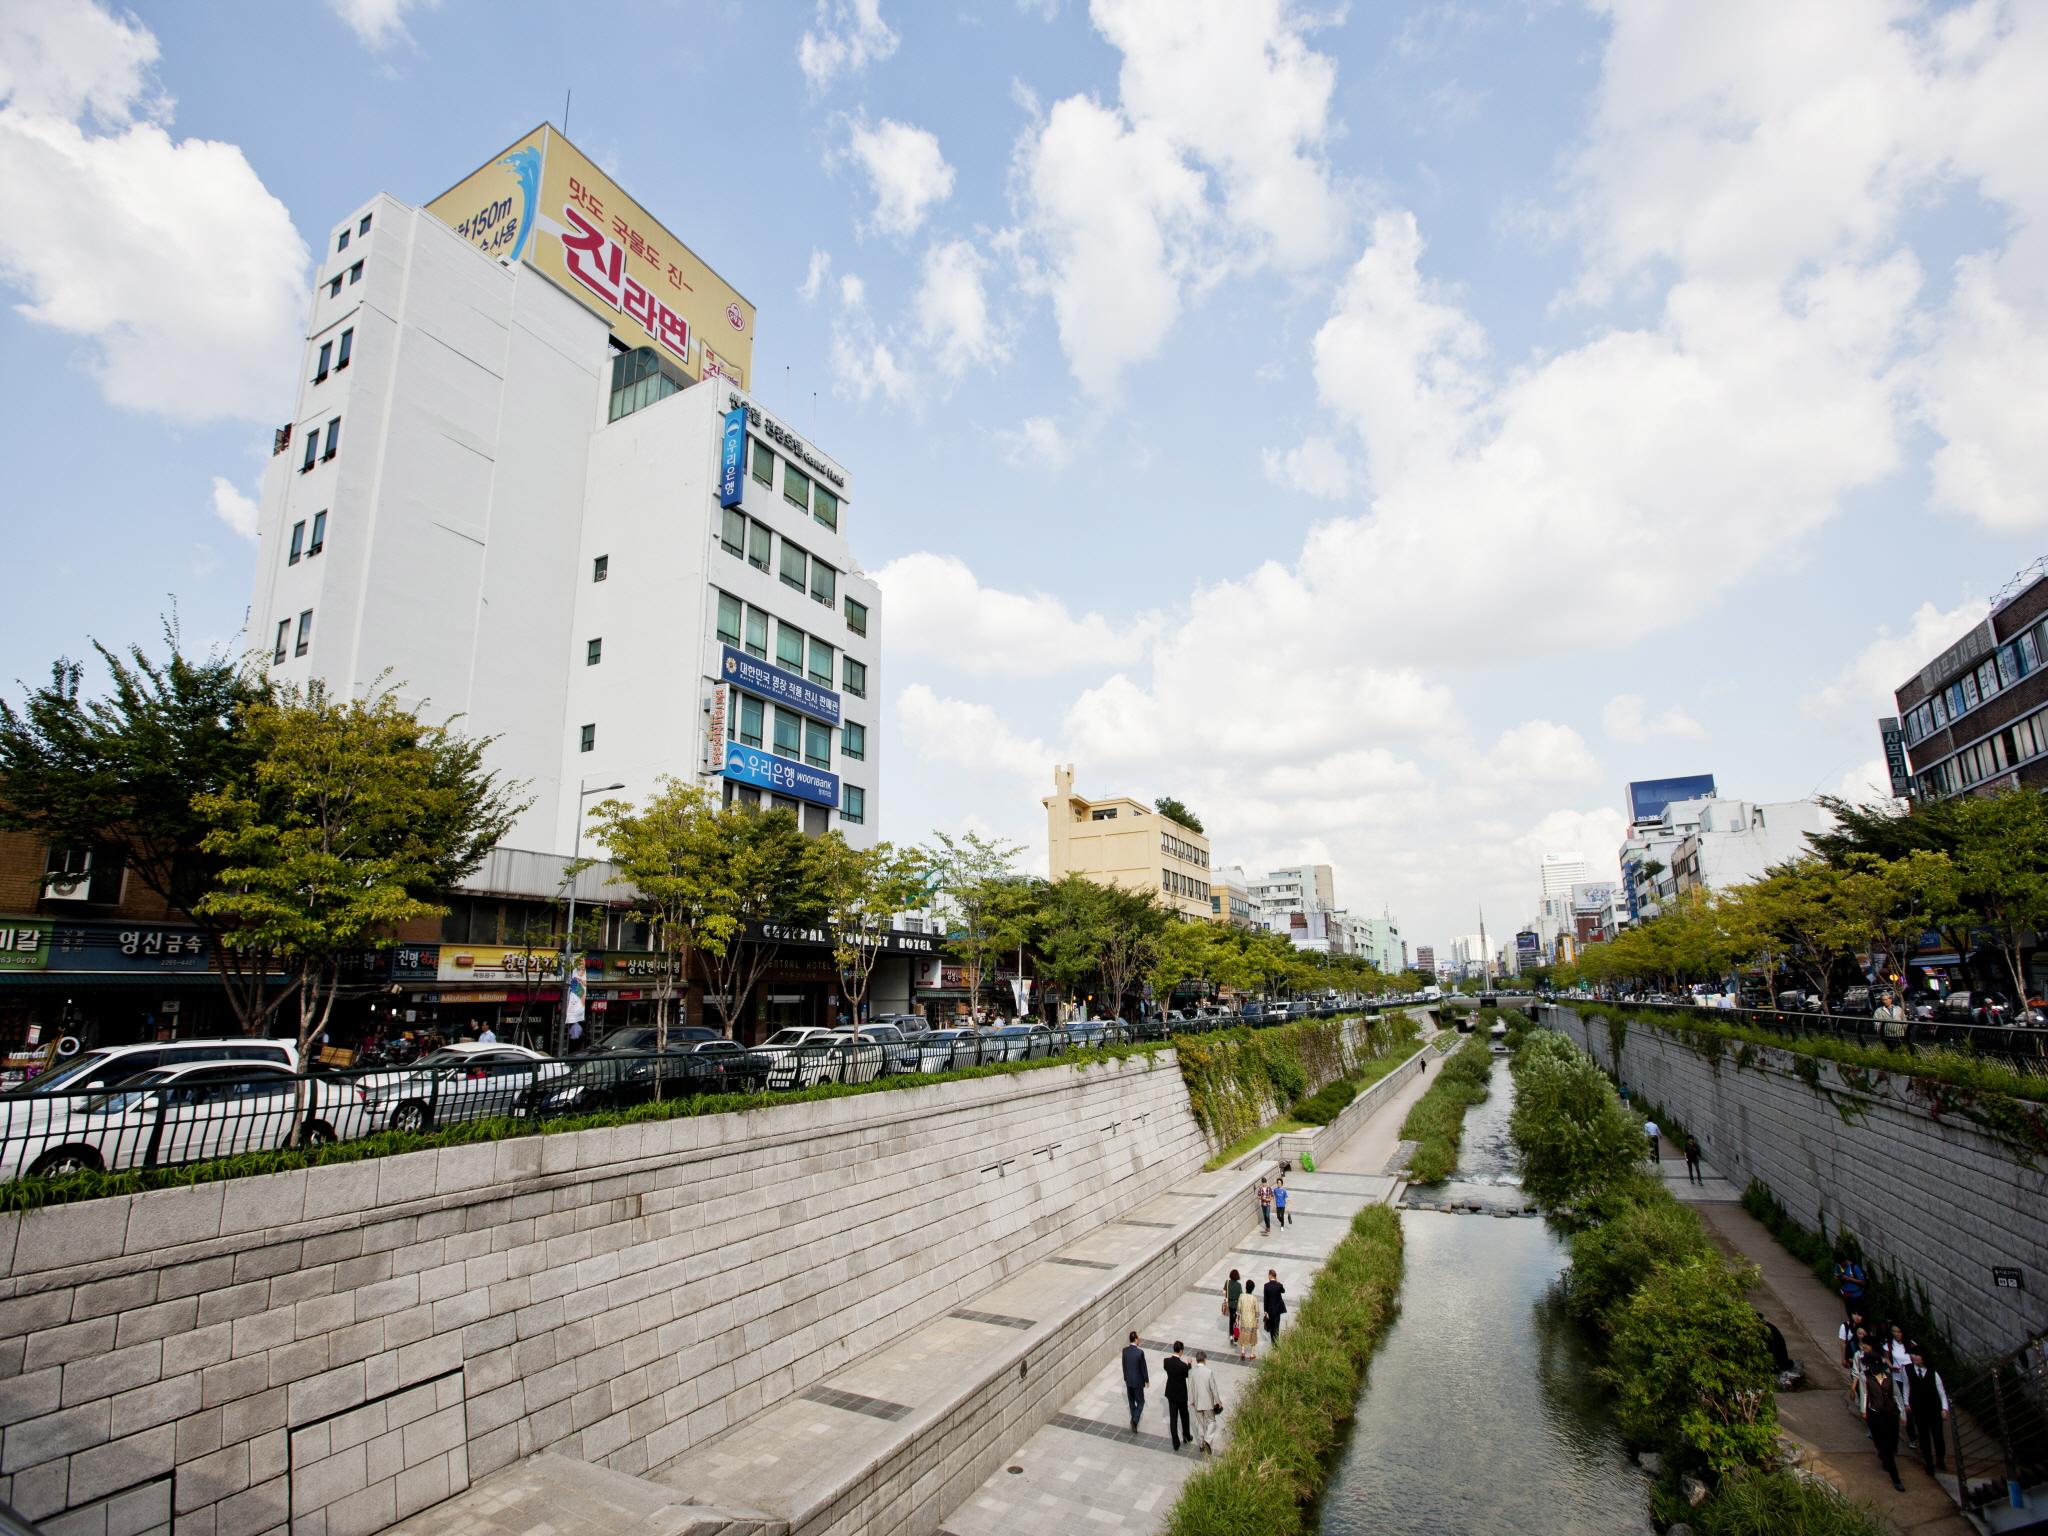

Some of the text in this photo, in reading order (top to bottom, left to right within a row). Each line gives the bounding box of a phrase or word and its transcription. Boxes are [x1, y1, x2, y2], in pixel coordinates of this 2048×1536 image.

[471, 197, 512, 240] 150m
[489, 217, 518, 251] 사용
[569, 176, 605, 223] 맛도
[611, 214, 661, 271] 국물도
[561, 207, 688, 358] 진라면
[724, 438, 737, 496] 우리은행
[739, 661, 771, 685] 대한민국
[772, 674, 787, 692] 명장
[788, 681, 803, 699] 작품
[803, 688, 819, 706] 전시
[819, 694, 839, 713] 판매관
[747, 755, 795, 788] 우리은행
[119, 931, 202, 954] 영신금속
[898, 937, 933, 951] HOTEL
[628, 959, 681, 975] 상신엔니링
[806, 960, 832, 971] HOTEL
[921, 962, 930, 980] P
